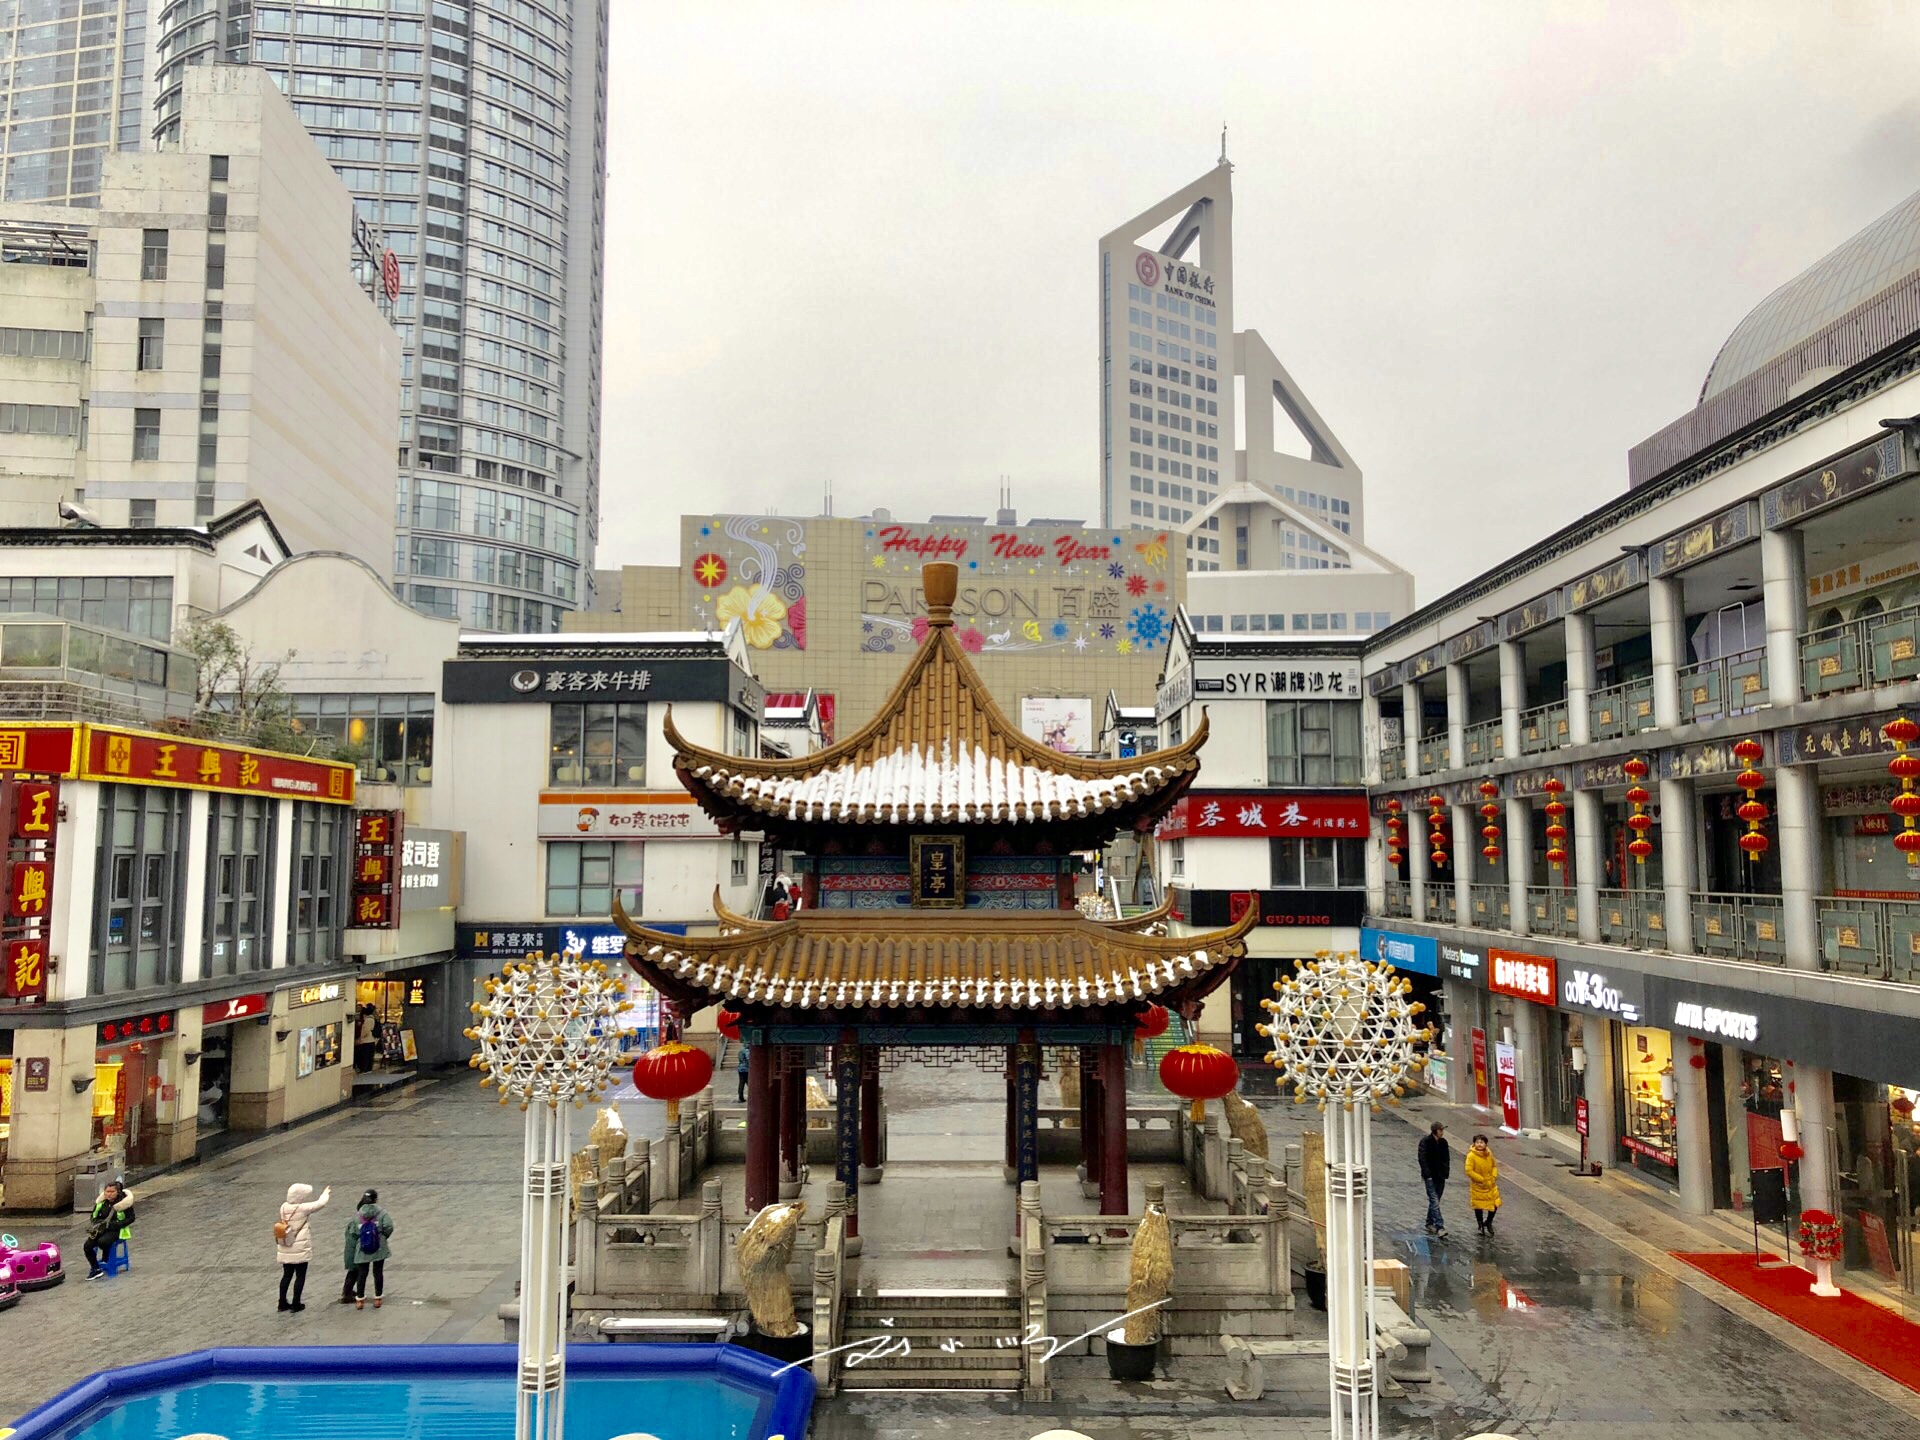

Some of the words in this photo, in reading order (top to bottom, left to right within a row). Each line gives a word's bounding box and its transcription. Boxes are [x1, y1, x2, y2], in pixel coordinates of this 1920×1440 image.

[1164, 284, 1184, 298] BANK
[1184, 291, 1194, 301] OF
[1194, 295, 1216, 308] CHINA
[879, 525, 968, 560] Happy
[989, 533, 1045, 560] New
[1052, 535, 1112, 566] Year
[860, 580, 1039, 616] PARSON
[1052, 585, 1121, 619] 百盛
[545, 670, 652, 692] 豪客来牛排
[609, 811, 690, 829] 如意馄饨
[1196, 801, 1308, 828] 蓉城巷
[930, 851, 946, 894] 皇亭
[1266, 915, 1296, 925] GUO
[1298, 915, 1330, 925] PING
[1703, 1007, 1758, 1042] SPORTS
[1500, 1057, 1514, 1070] SALE
